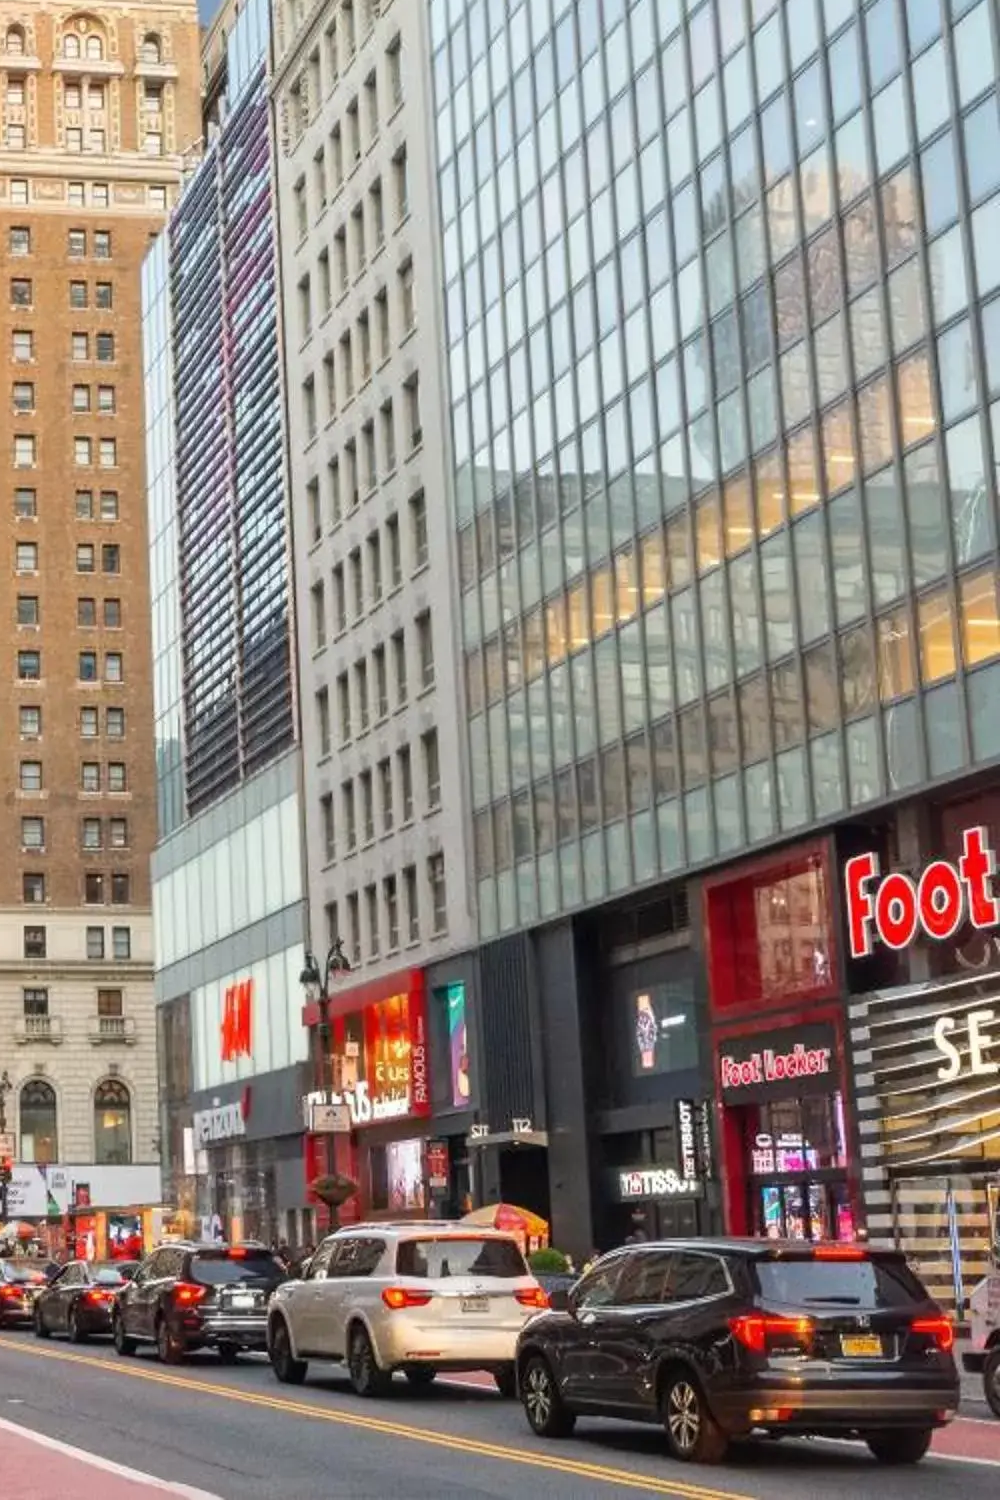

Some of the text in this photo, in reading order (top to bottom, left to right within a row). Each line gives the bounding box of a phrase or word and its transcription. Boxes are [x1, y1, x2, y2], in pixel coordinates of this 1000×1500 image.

[846, 826, 1000, 958] Foot
[413, 1045, 428, 1102] FAMOUS
[722, 1044, 831, 1088] Foot Locker
[934, 1010, 1000, 1080] SE
[679, 1100, 694, 1158] TISSOT
